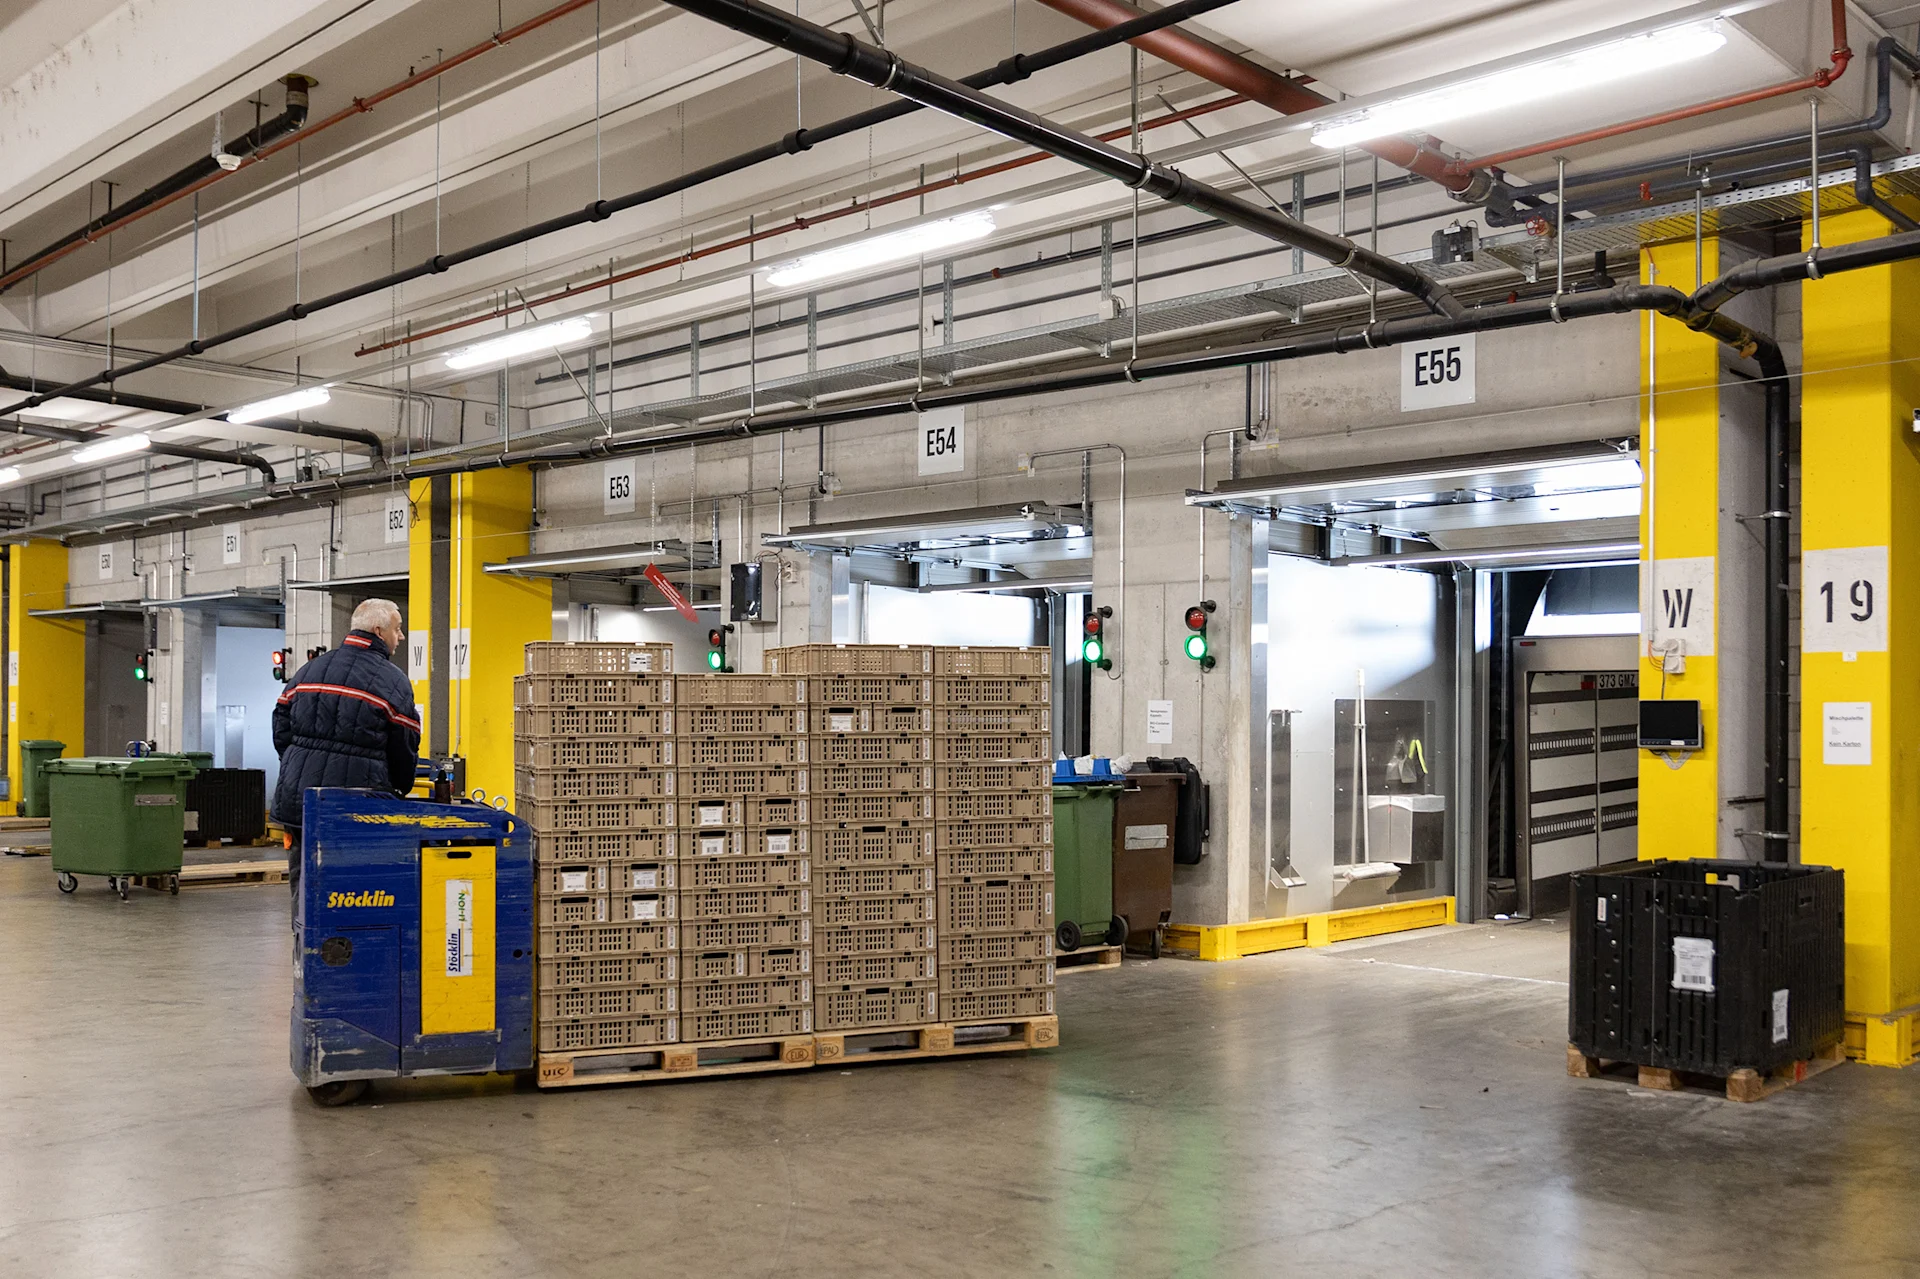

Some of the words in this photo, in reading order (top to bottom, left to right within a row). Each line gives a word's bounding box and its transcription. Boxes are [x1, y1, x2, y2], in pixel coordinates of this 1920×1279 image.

[1414, 346, 1461, 387] E55
[926, 427, 957, 458] E54
[609, 475, 630, 499] E53
[389, 509, 404, 530] E52
[226, 535, 237, 552] E51
[1662, 588, 1693, 628] W
[1820, 579, 1873, 623] 19
[413, 645, 423, 667] W
[454, 643, 468, 665] 17
[1599, 674, 1616, 688] 373
[1618, 673, 1635, 687] GMZ
[327, 890, 395, 908] Stöcklin
[458, 892, 466, 922] LI-ION
[447, 933, 458, 972] Stöcklin
[790, 1050, 804, 1060] EUR
